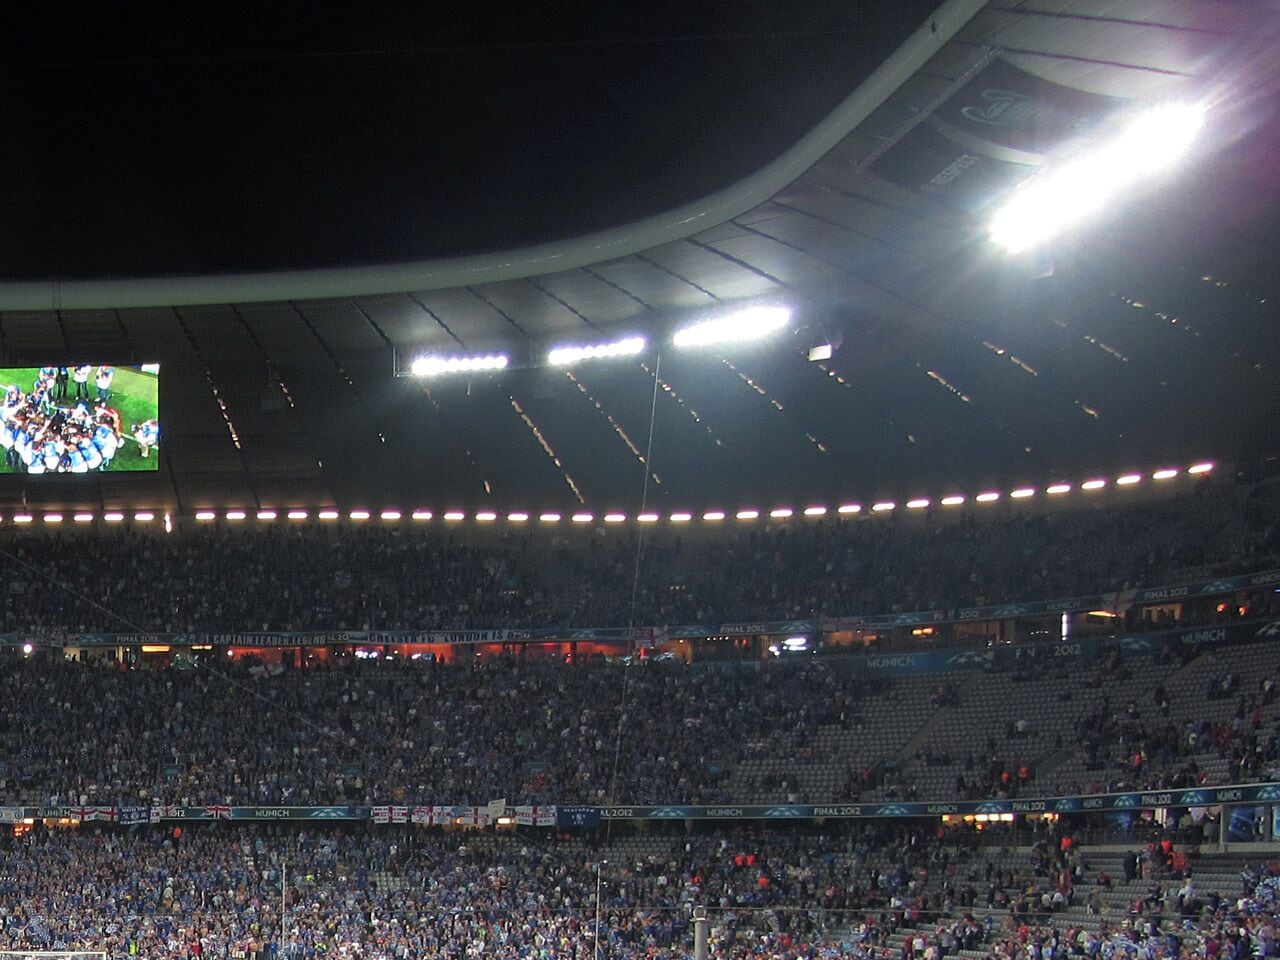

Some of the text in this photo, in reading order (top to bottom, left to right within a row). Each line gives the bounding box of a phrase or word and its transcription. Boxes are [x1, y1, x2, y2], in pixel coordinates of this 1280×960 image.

[1180, 629, 1226, 644] MUNICH
[1054, 643, 1082, 655] 2012
[867, 655, 916, 669] MUNICH
[255, 809, 290, 817] MUNICH
[611, 808, 634, 817] 2012
[707, 808, 743, 817] MUNICH
[814, 806, 861, 816] FINAL 2012
